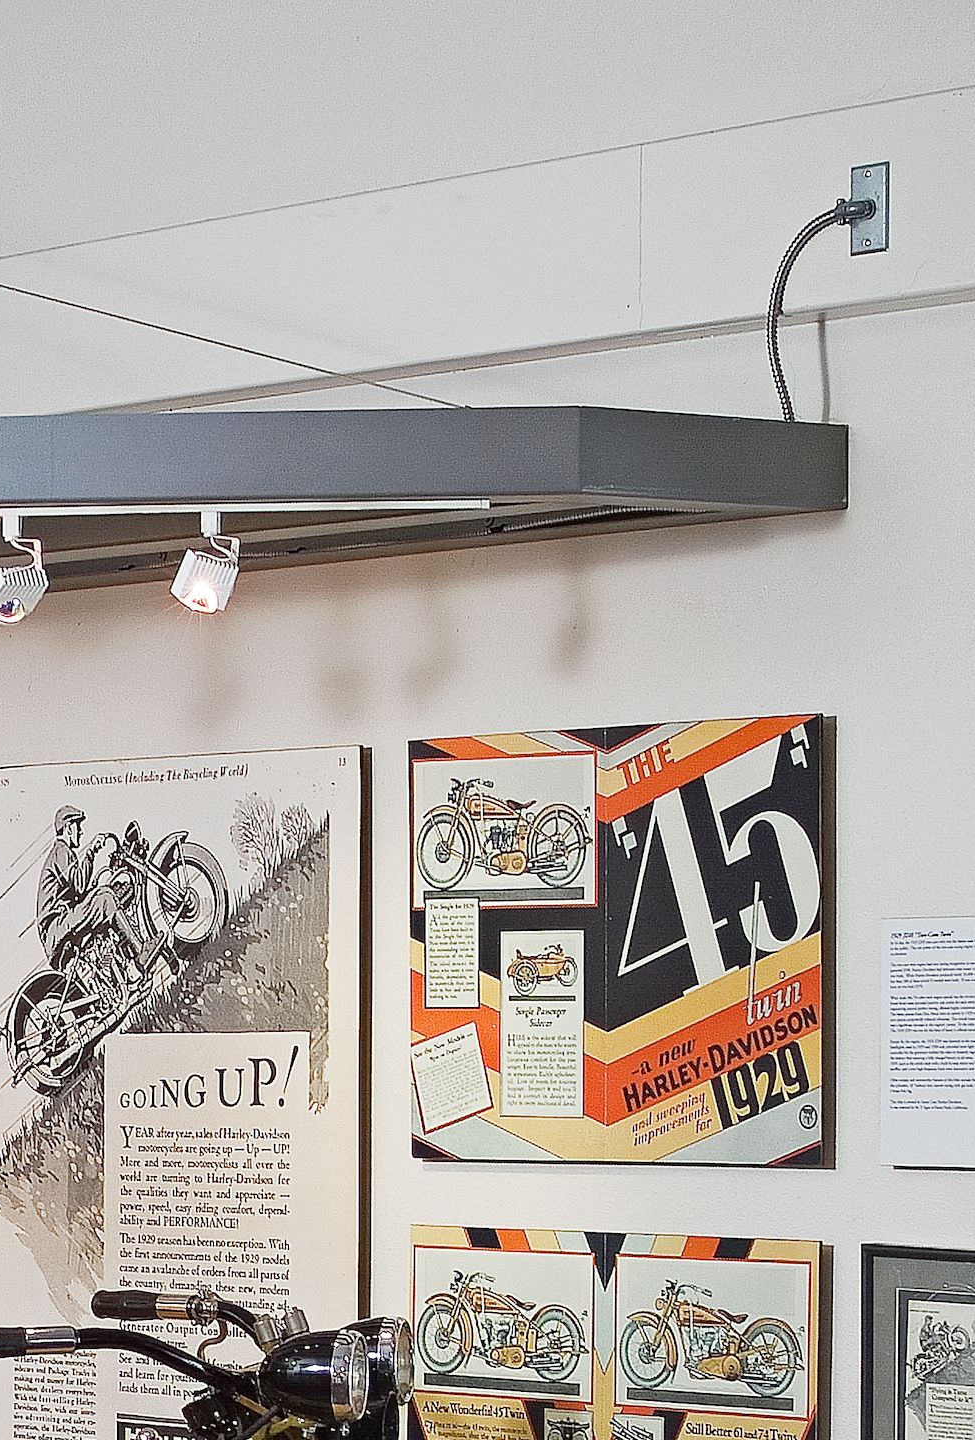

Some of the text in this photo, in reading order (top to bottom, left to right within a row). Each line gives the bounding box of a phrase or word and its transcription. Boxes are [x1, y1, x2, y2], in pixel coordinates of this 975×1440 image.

[617, 742, 676, 786] THE
[167, 770, 181, 781] The
[183, 768, 218, 782] Bicycling
[622, 1004, 817, 1112] HARLEY-DAVIDSON
[658, 1039, 696, 1067] new
[120, 1046, 298, 1108] GOING UP!
[710, 1040, 810, 1130] 1929
[632, 1092, 706, 1133] and sweeping
[633, 1105, 710, 1146] improvements
[695, 1118, 712, 1134] for
[157, 1128, 175, 1139] after
[196, 1128, 212, 1139] sales
[215, 1128, 224, 1139] of
[224, 1128, 290, 1141] Harley-Davidson
[138, 1142, 183, 1156] motorcycles
[199, 1146, 221, 1156] going
[223, 1147, 233, 1157] up
[247, 1144, 259, 1157] Up
[274, 1144, 290, 1154] UP!
[145, 1157, 158, 1167] and
[188, 1159, 238, 1171] motorcyclists
[243, 1159, 252, 1169] all
[256, 1161, 273, 1169] over
[278, 1159, 290, 1169] the
[120, 1173, 141, 1182] world
[162, 1174, 190, 1186] turning
[195, 1175, 202, 1183] to
[208, 1173, 273, 1186] Harley-Davidson
[278, 1174, 290, 1184] for
[121, 1187, 275, 1202] the qualities they want and appreciate
[175, 1206, 191, 1215] easy
[196, 1205, 218, 1216] riding
[258, 1204, 290, 1219] depend-
[120, 1216, 239, 1229] ability and PERFORMANCE!
[120, 1233, 136, 1244] The
[138, 1235, 155, 1244] 1929
[157, 1238, 181, 1246] season
[183, 1236, 195, 1246] has
[197, 1238, 215, 1247] been
[269, 1239, 289, 1250] With
[120, 1248, 289, 1266] the first announcements of the 1929 models
[120, 1265, 139, 1273] came
[152, 1264, 190, 1276] avalanche
[191, 1265, 200, 1276] of
[202, 1266, 225, 1277] orders
[228, 1267, 246, 1278] from
[248, 1268, 258, 1279] all
[261, 1271, 281, 1283] parts
[282, 1270, 289, 1281] of
[120, 1278, 132, 1287] the
[216, 1281, 235, 1293] these
[259, 1285, 289, 1295] modern
[166, 1323, 199, 1335] Output
[119, 1353, 149, 1365] See and
[119, 1369, 169, 1381] and learn for
[119, 1381, 182, 1396] leads them all in
[493, 1407, 505, 1417] 45
[504, 1407, 525, 1419] Twin
[705, 1424, 732, 1437] Better
